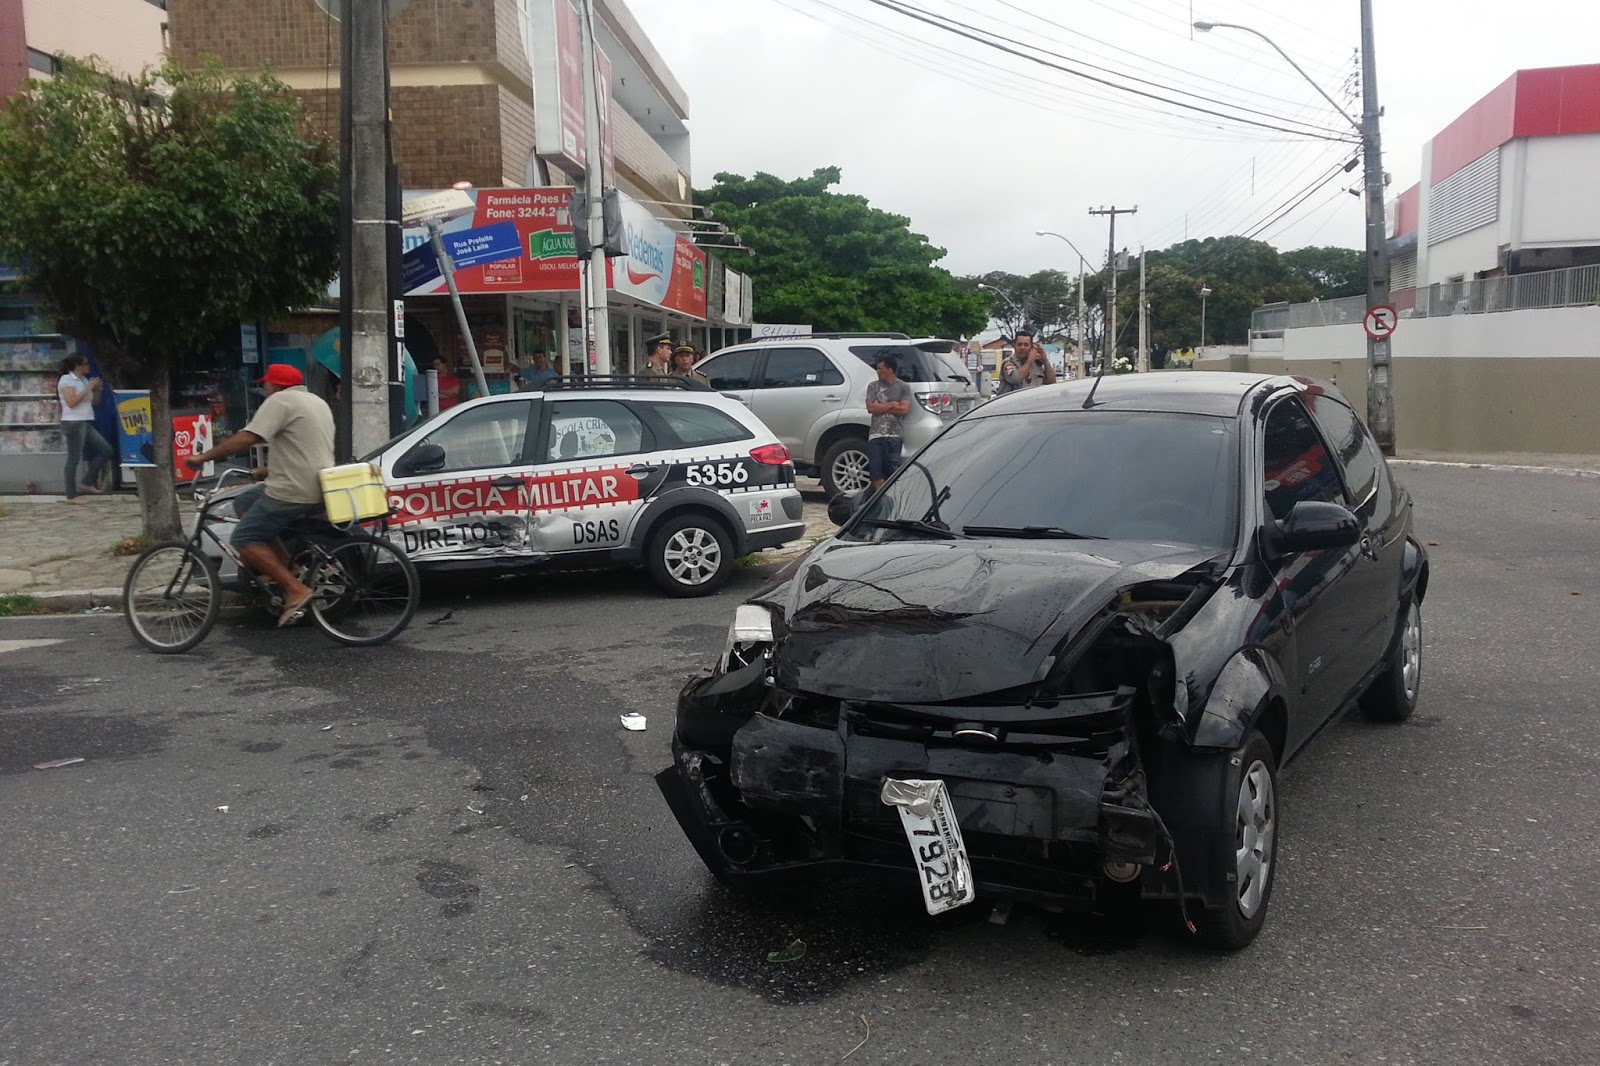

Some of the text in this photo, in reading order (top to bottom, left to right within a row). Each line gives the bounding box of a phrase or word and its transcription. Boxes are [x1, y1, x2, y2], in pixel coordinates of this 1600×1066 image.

[487, 194, 531, 205] Farmácia
[534, 194, 559, 204] Paes
[487, 208, 515, 218] Fone:
[453, 235, 493, 249] Rua Prefeito
[456, 243, 489, 255] José Leite
[542, 238, 561, 252] ÁGUA
[628, 223, 663, 273] Redemais
[558, 262, 579, 270] MELHO
[122, 413, 143, 428] TIM
[556, 419, 609, 439] SCOLA CRIA
[686, 462, 748, 486] 5356
[389, 476, 618, 518] POLÍCIA MILITAR
[573, 519, 619, 544] DSAS
